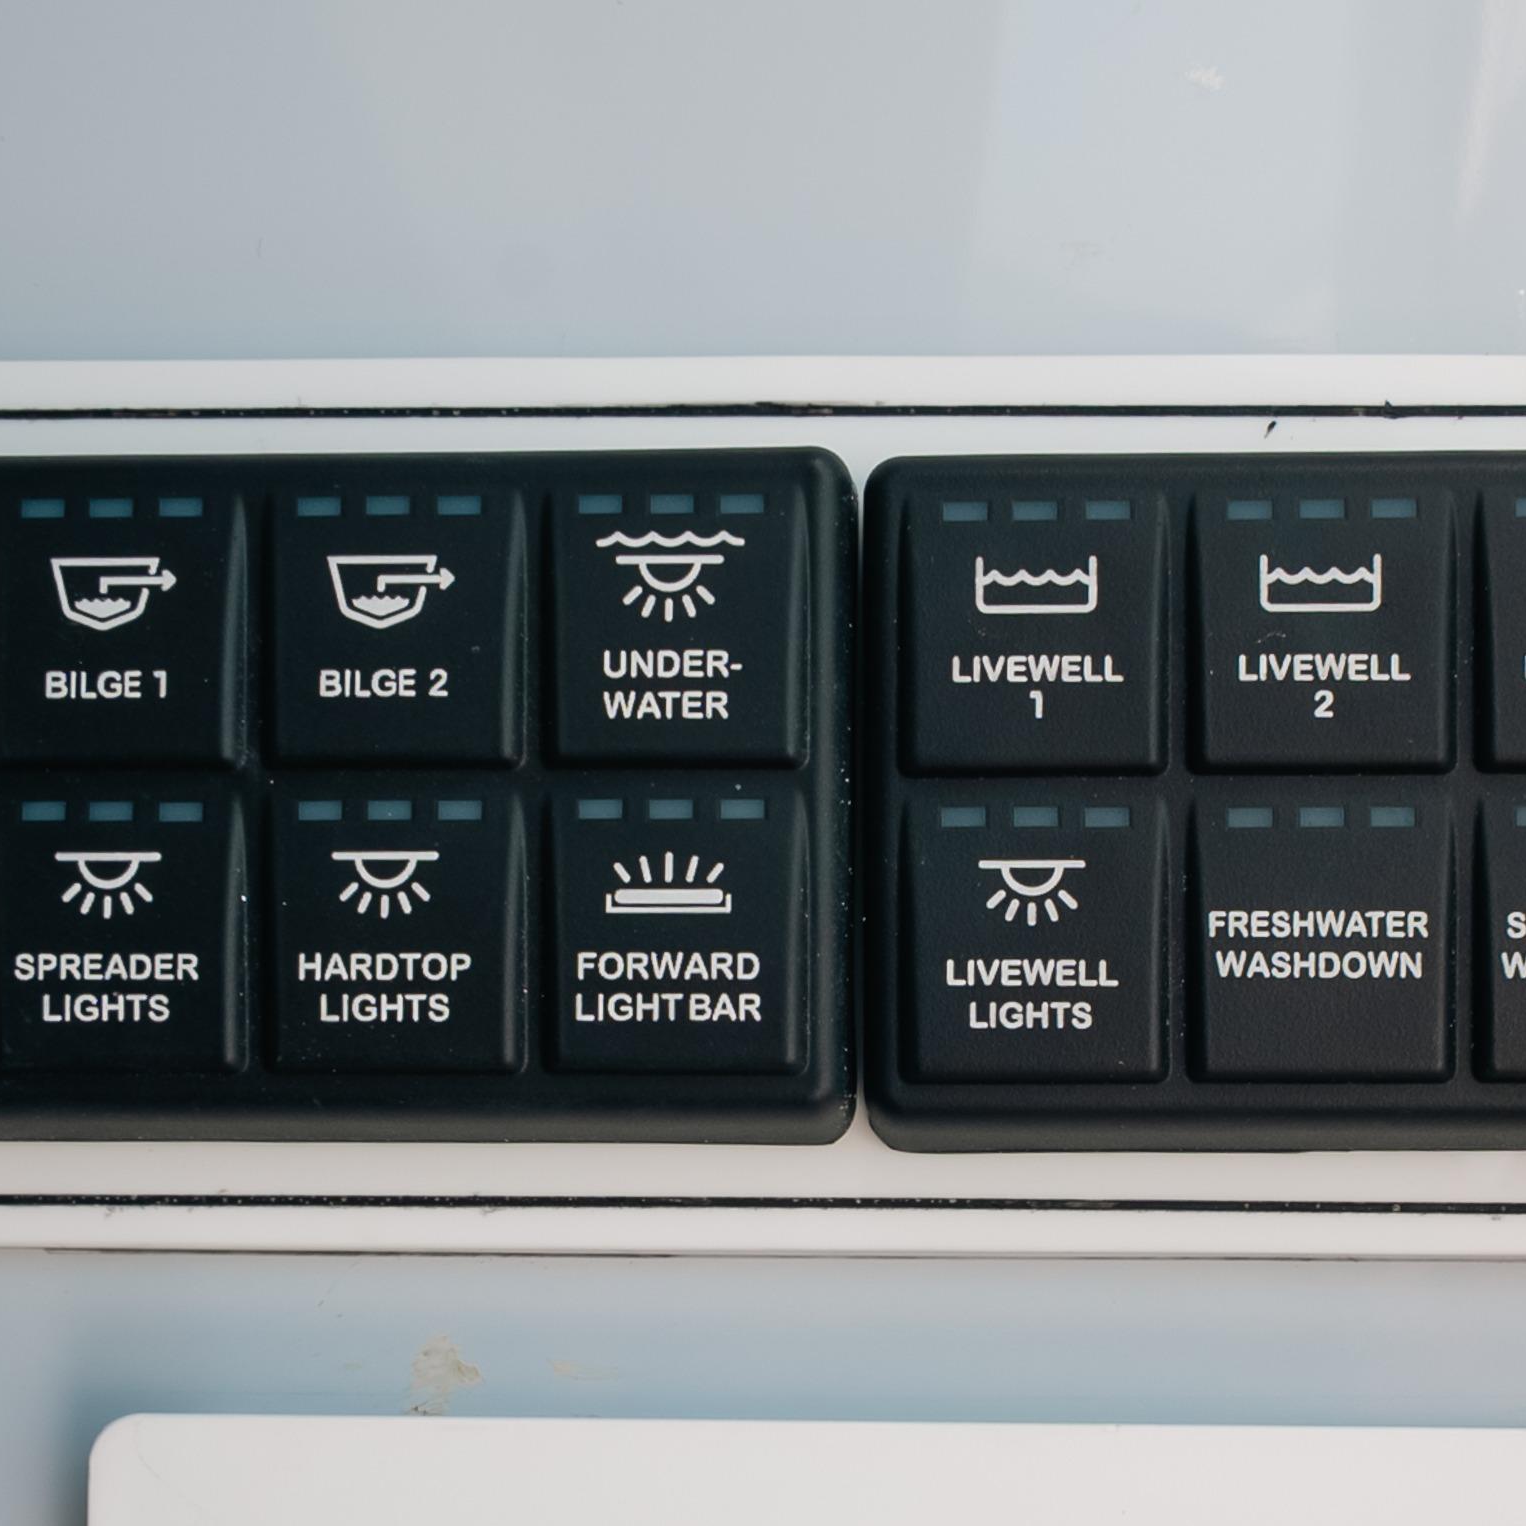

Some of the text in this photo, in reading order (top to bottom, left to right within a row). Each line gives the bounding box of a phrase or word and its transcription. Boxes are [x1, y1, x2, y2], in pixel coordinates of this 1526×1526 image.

[603, 649, 743, 679] UNDER-
[952, 654, 1125, 683] LIVEWELL
[1238, 652, 1412, 682] LIVEWELL
[45, 670, 167, 699] BILGE 1
[319, 668, 449, 698] BILGE 2
[603, 690, 729, 720] WATER
[1029, 690, 1044, 719] 1
[1313, 689, 1334, 719] 2
[1208, 909, 1429, 939] FRESHWATER
[14, 953, 199, 981] SPREADER
[298, 952, 472, 982] HARDTOP
[577, 951, 761, 981] FORWARD
[946, 958, 1120, 988] LIVEWELL
[1215, 949, 1423, 979] WASHDOWN
[42, 993, 170, 1022] LIGHTS
[320, 993, 450, 1023] LIGHTS
[969, 1001, 1093, 1030] LIGHTS
